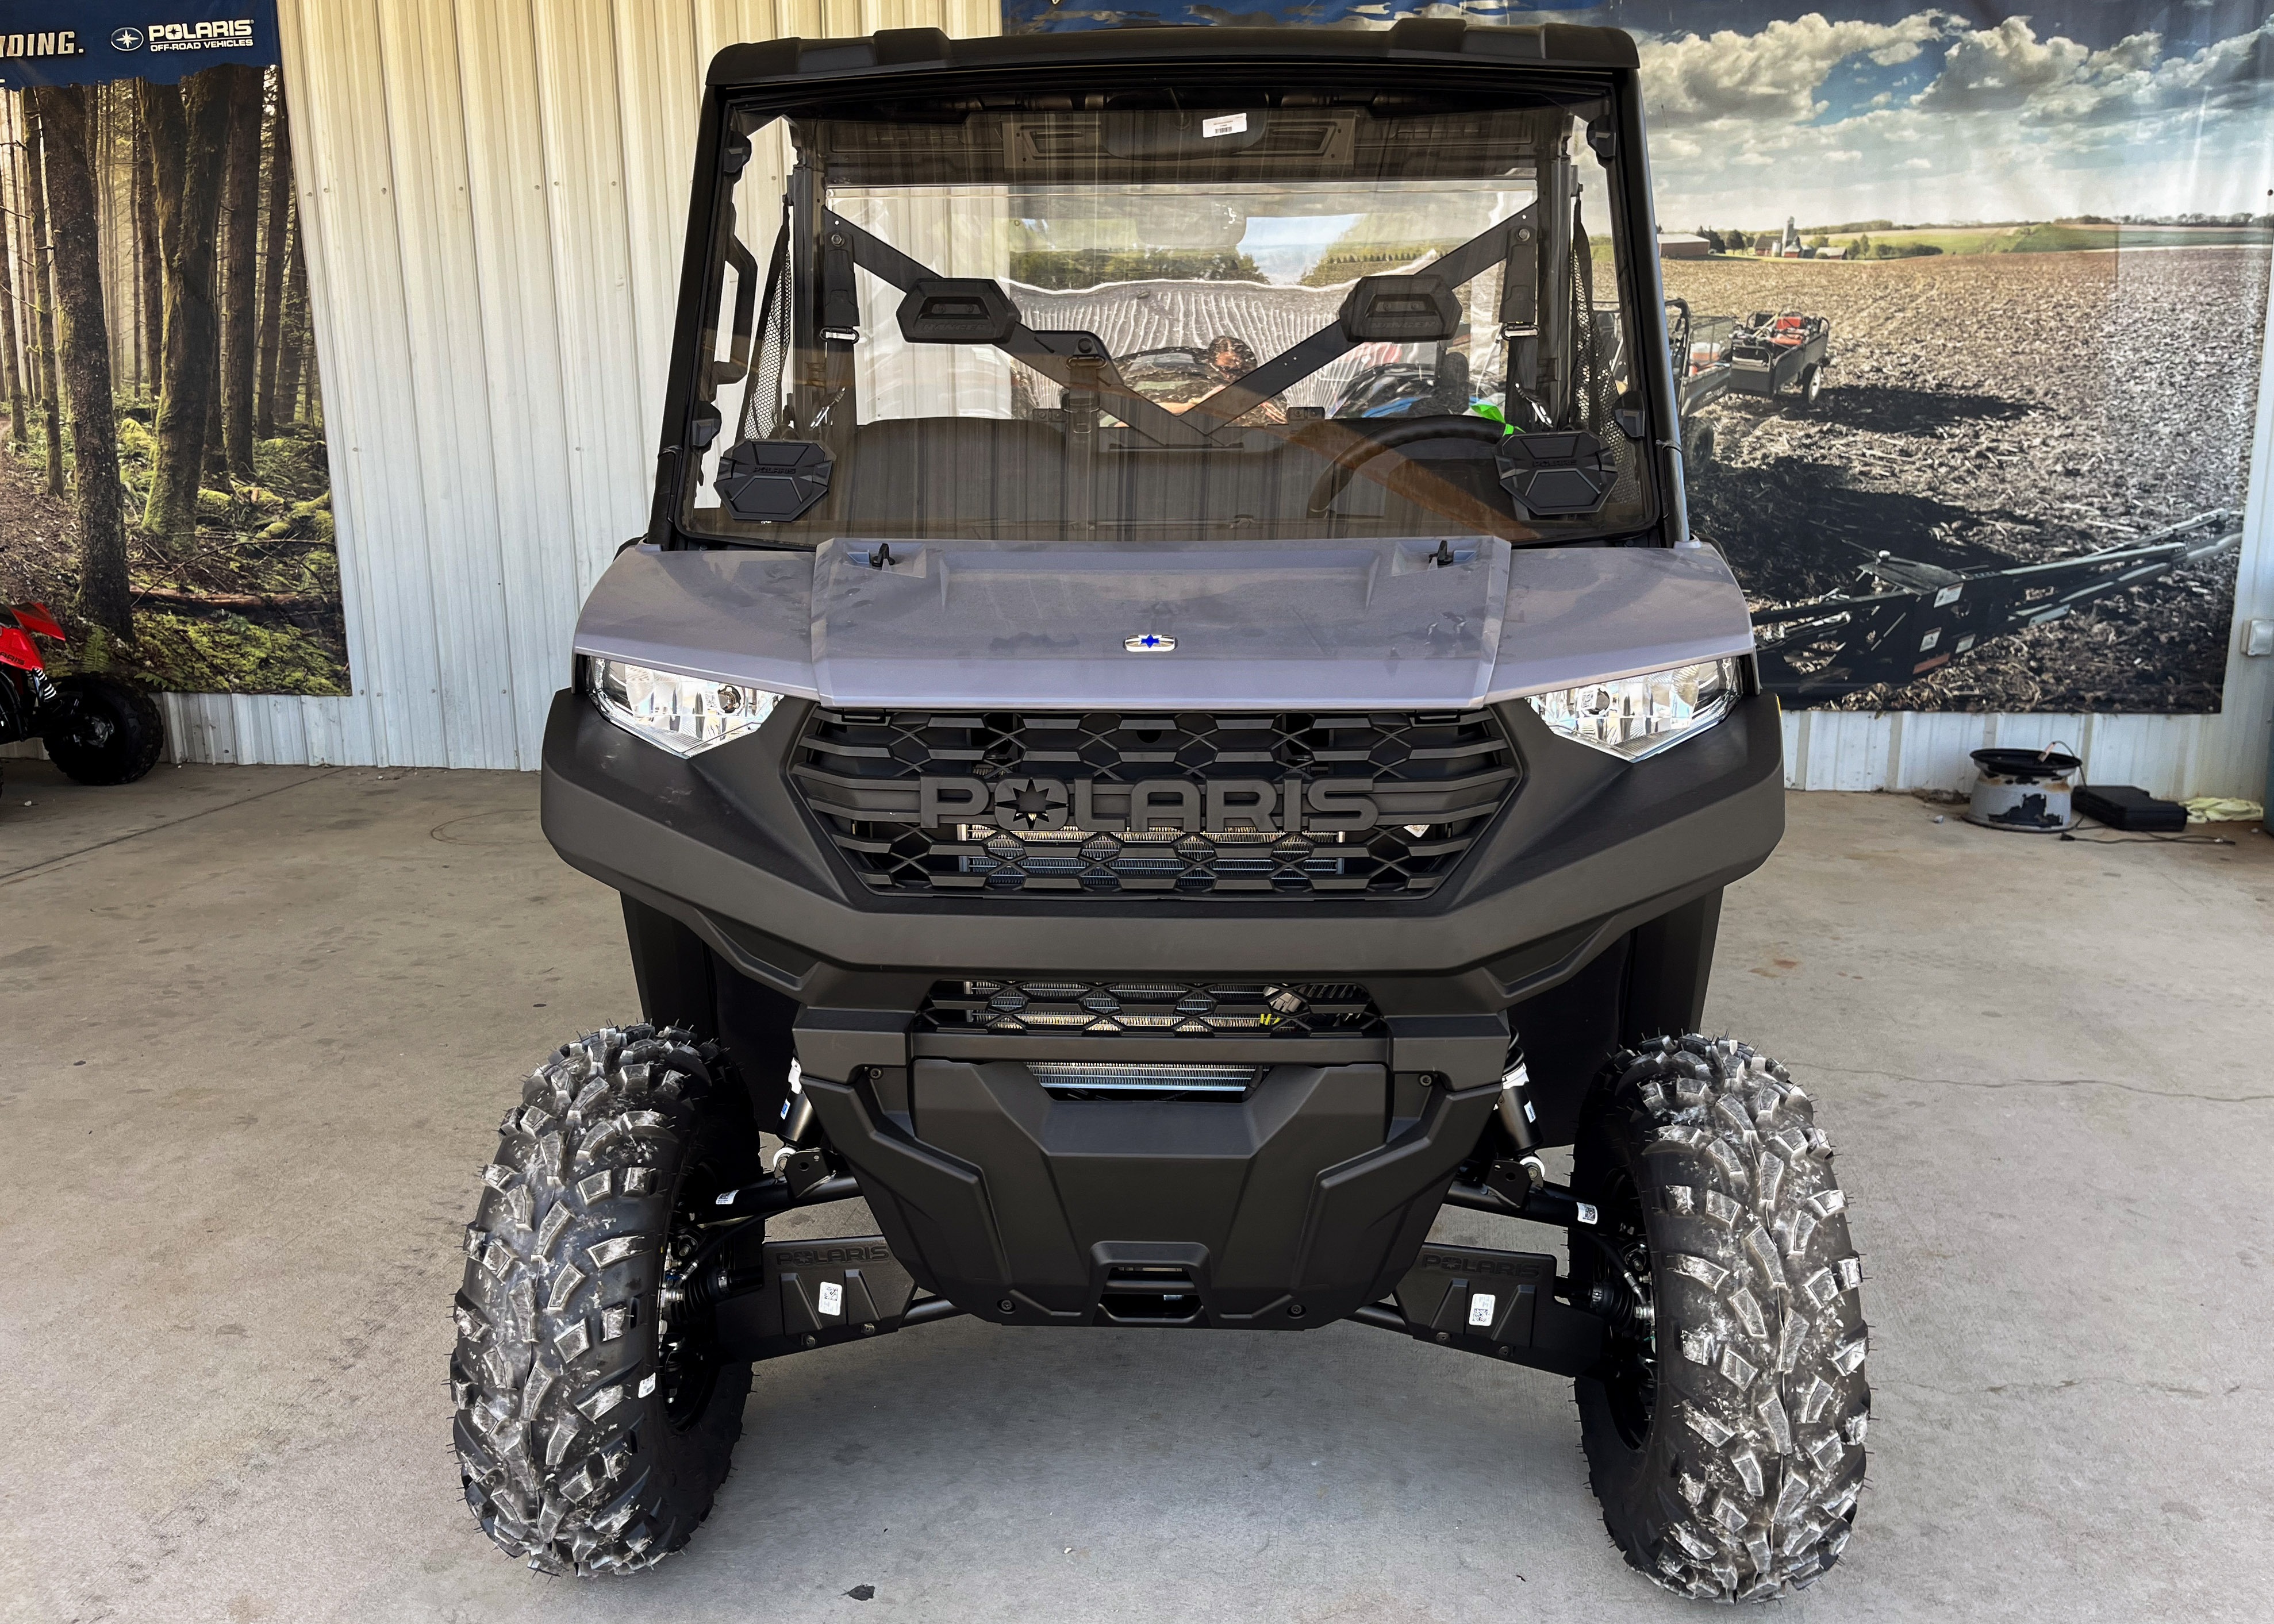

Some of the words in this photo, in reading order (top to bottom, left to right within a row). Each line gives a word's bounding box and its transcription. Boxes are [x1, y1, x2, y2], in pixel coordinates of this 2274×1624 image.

[148, 19, 252, 41] POLARIS
[150, 41, 201, 52] OFF-ROAD
[203, 39, 253, 48] VEHICLES
[753, 466, 797, 474] POLARIS
[920, 775, 1378, 833] POLARIS
[776, 1245, 890, 1266] POLARIS
[1422, 1253, 1541, 1279] POLARIS
